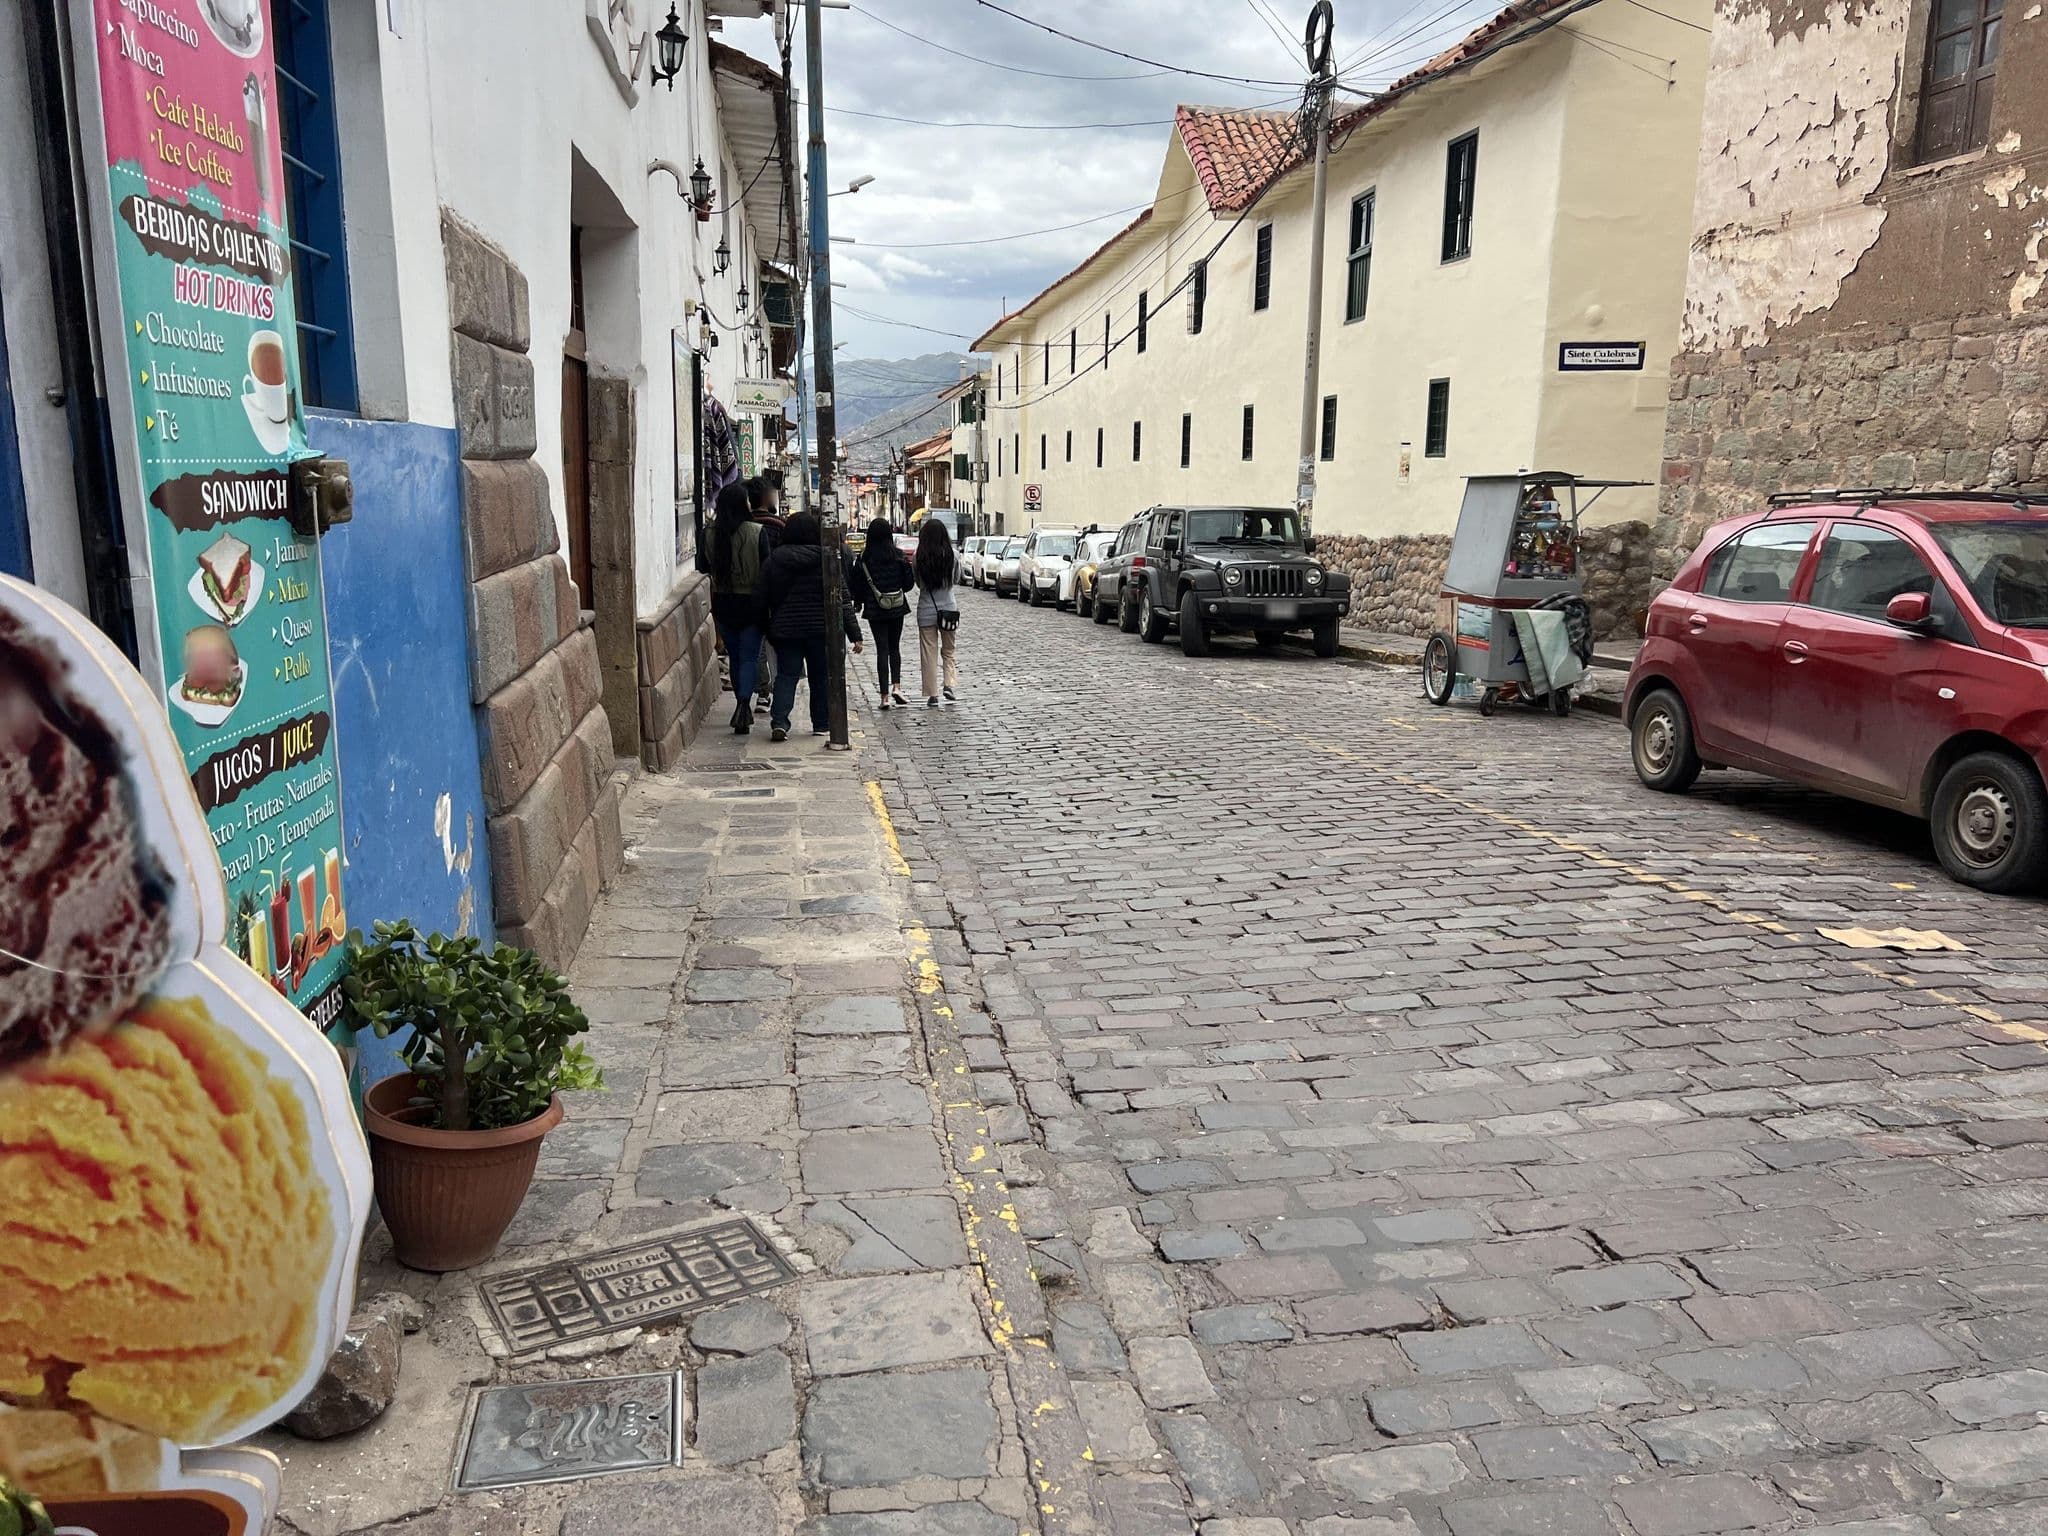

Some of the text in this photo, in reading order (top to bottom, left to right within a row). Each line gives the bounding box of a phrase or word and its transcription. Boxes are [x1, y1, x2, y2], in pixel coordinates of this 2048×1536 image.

[120, 0, 199, 48] apuccino
[117, 22, 165, 77] Moca
[153, 85, 244, 154] Cafe Helado
[156, 129, 234, 187] Ice Coffee
[133, 195, 283, 276] BEBIDAS CALIENTES
[174, 262, 275, 321] HOT DRINKS
[145, 311, 225, 353] Chocolate
[1567, 349, 1637, 358] Siete Culebras
[150, 359, 232, 399] Infusiones
[156, 410, 179, 441] Té
[200, 479, 288, 519] SANDWICH
[277, 575, 309, 604] Mixto
[280, 615, 314, 647] Queso
[282, 651, 312, 684] Pollo
[212, 743, 264, 806] JUGOS
[282, 718, 315, 772] JUICE
[208, 818, 235, 848] xto
[243, 795, 286, 834] Frutas
[284, 762, 333, 808] Naturales
[255, 831, 276, 864] De
[276, 794, 336, 851] Temporada
